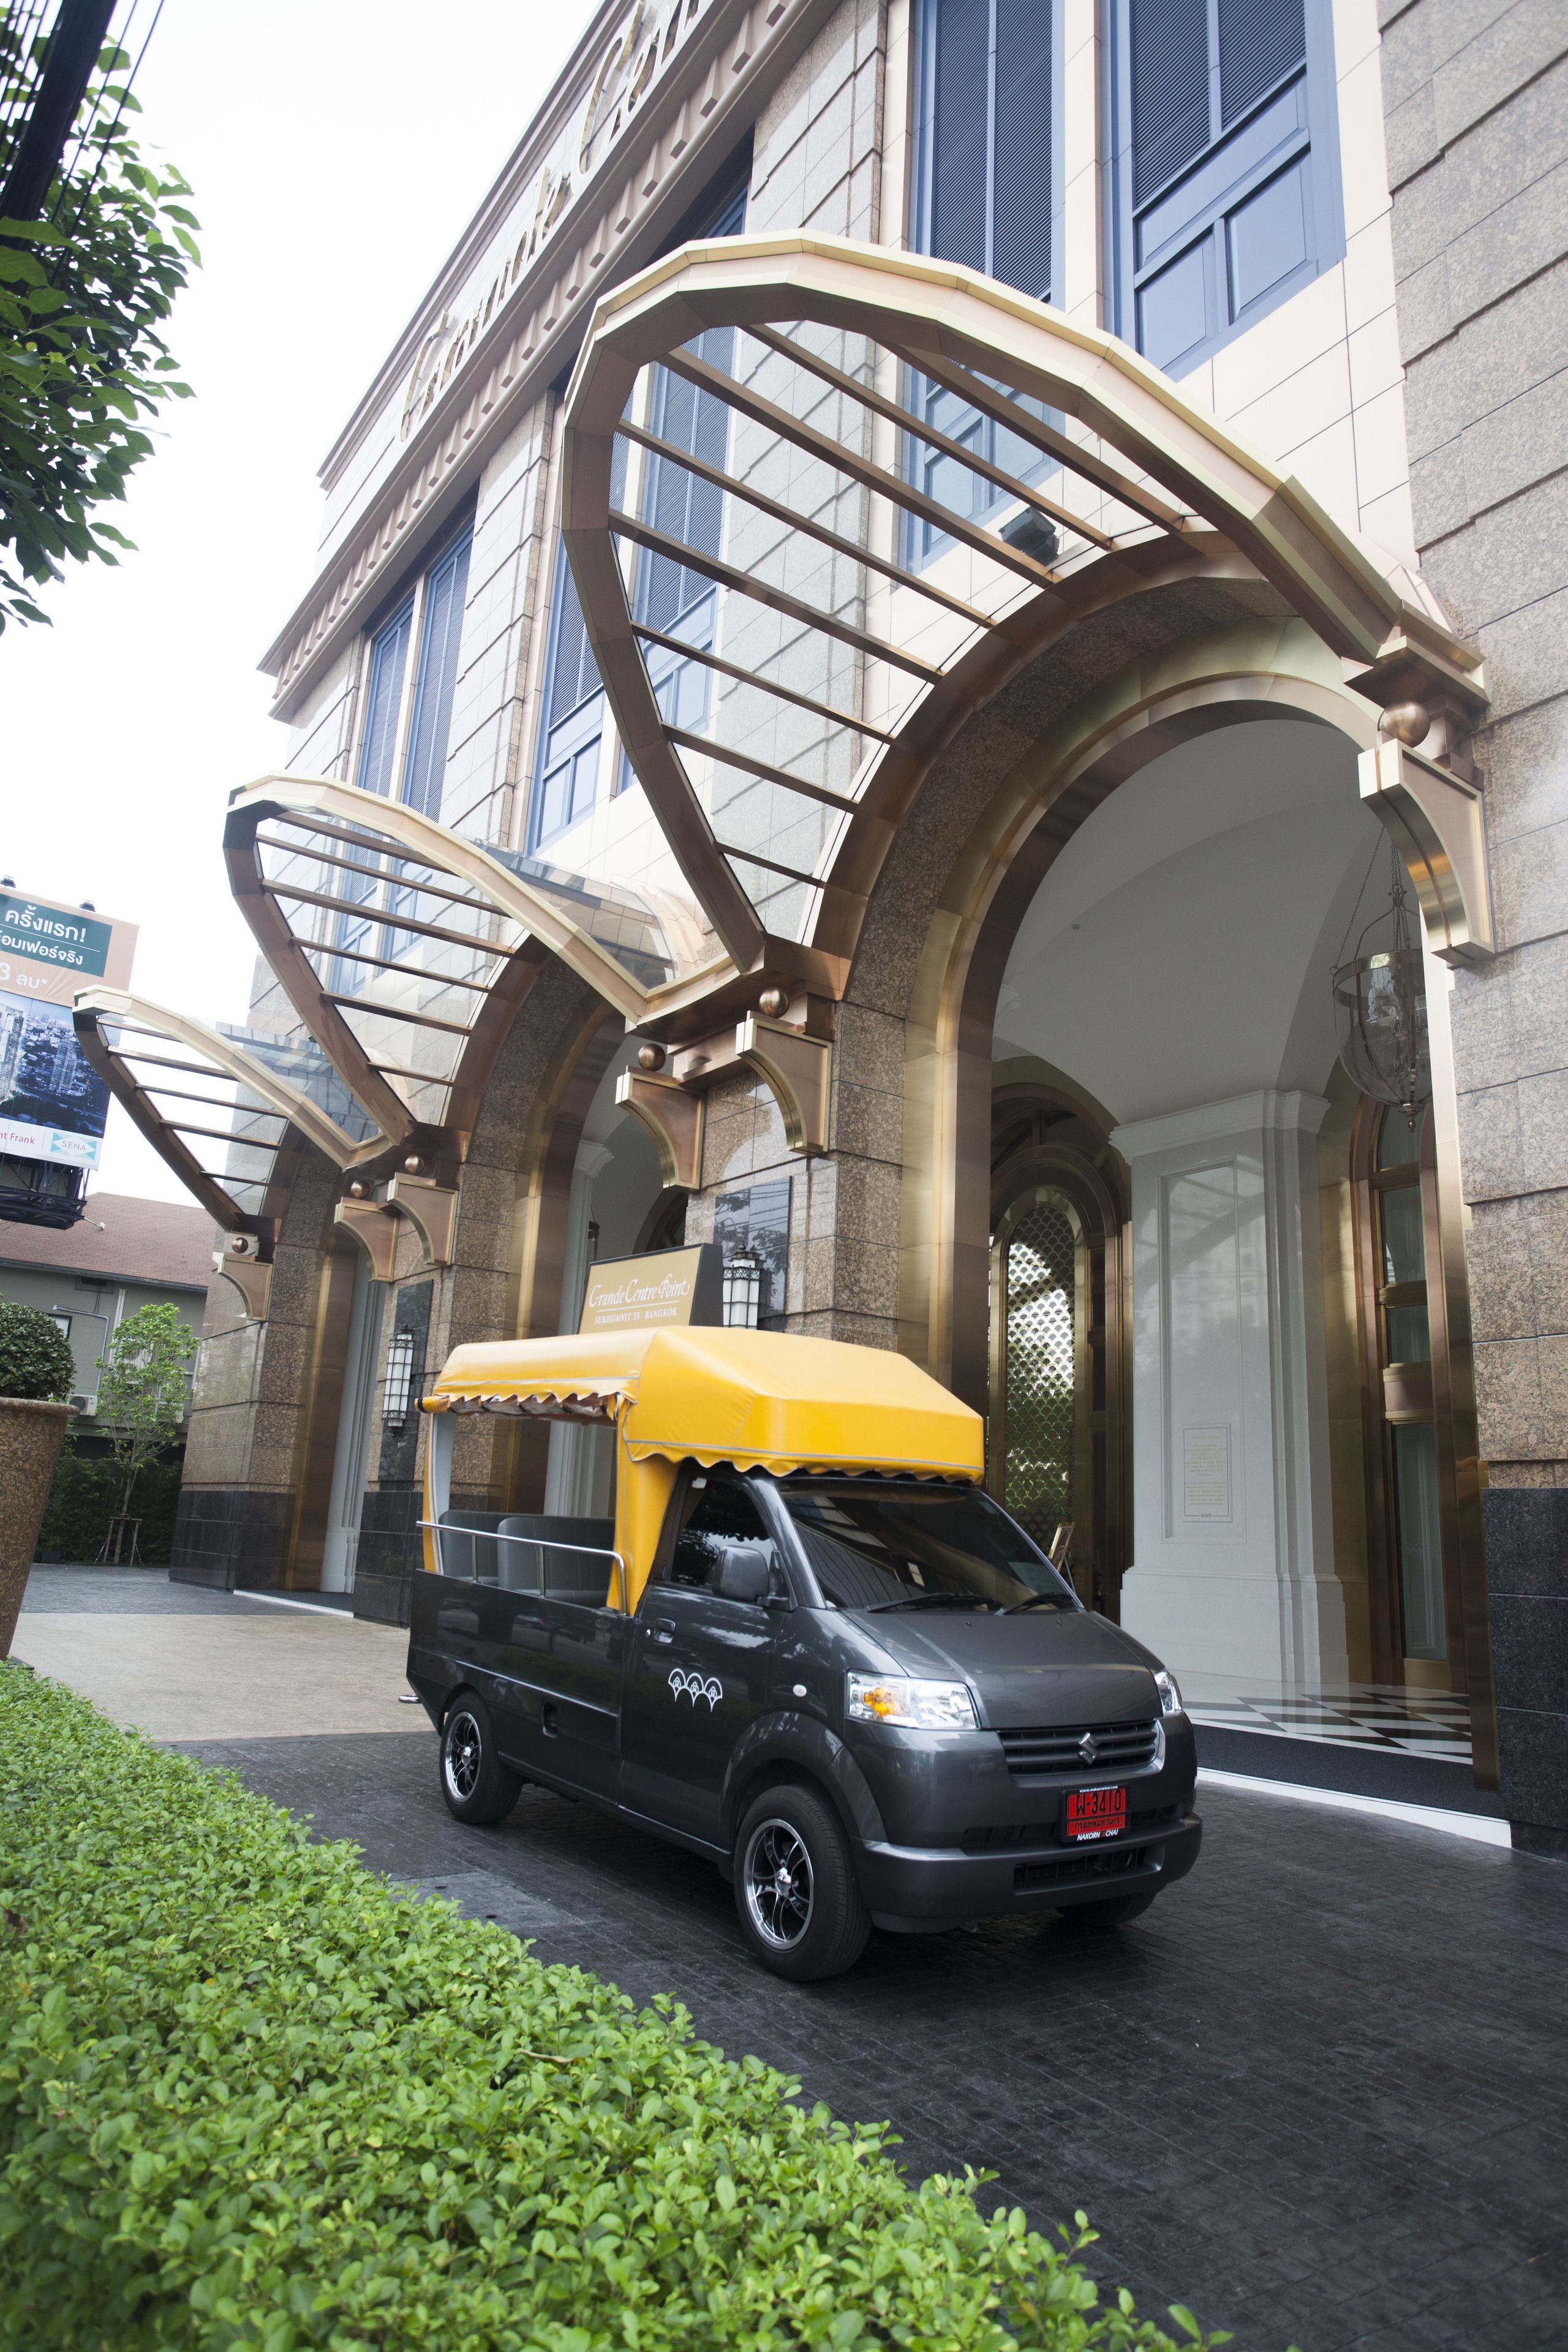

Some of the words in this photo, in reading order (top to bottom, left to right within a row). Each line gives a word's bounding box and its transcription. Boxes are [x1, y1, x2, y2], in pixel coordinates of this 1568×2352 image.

[5, 905, 86, 943] ครั้งแรก!
[10, 1133, 35, 1145] Frank
[61, 1140, 86, 1151] SENA
[589, 1284, 625, 1307] Grande
[625, 1278, 658, 1303] Centre
[657, 1273, 690, 1299] Point
[595, 1311, 632, 1325] SUKHUMVIT
[633, 1311, 641, 1321] 55
[644, 1307, 677, 1319] BANGKOK
[1077, 1831, 1101, 1841] NAKORN
[1105, 1828, 1118, 1837] CHAI
